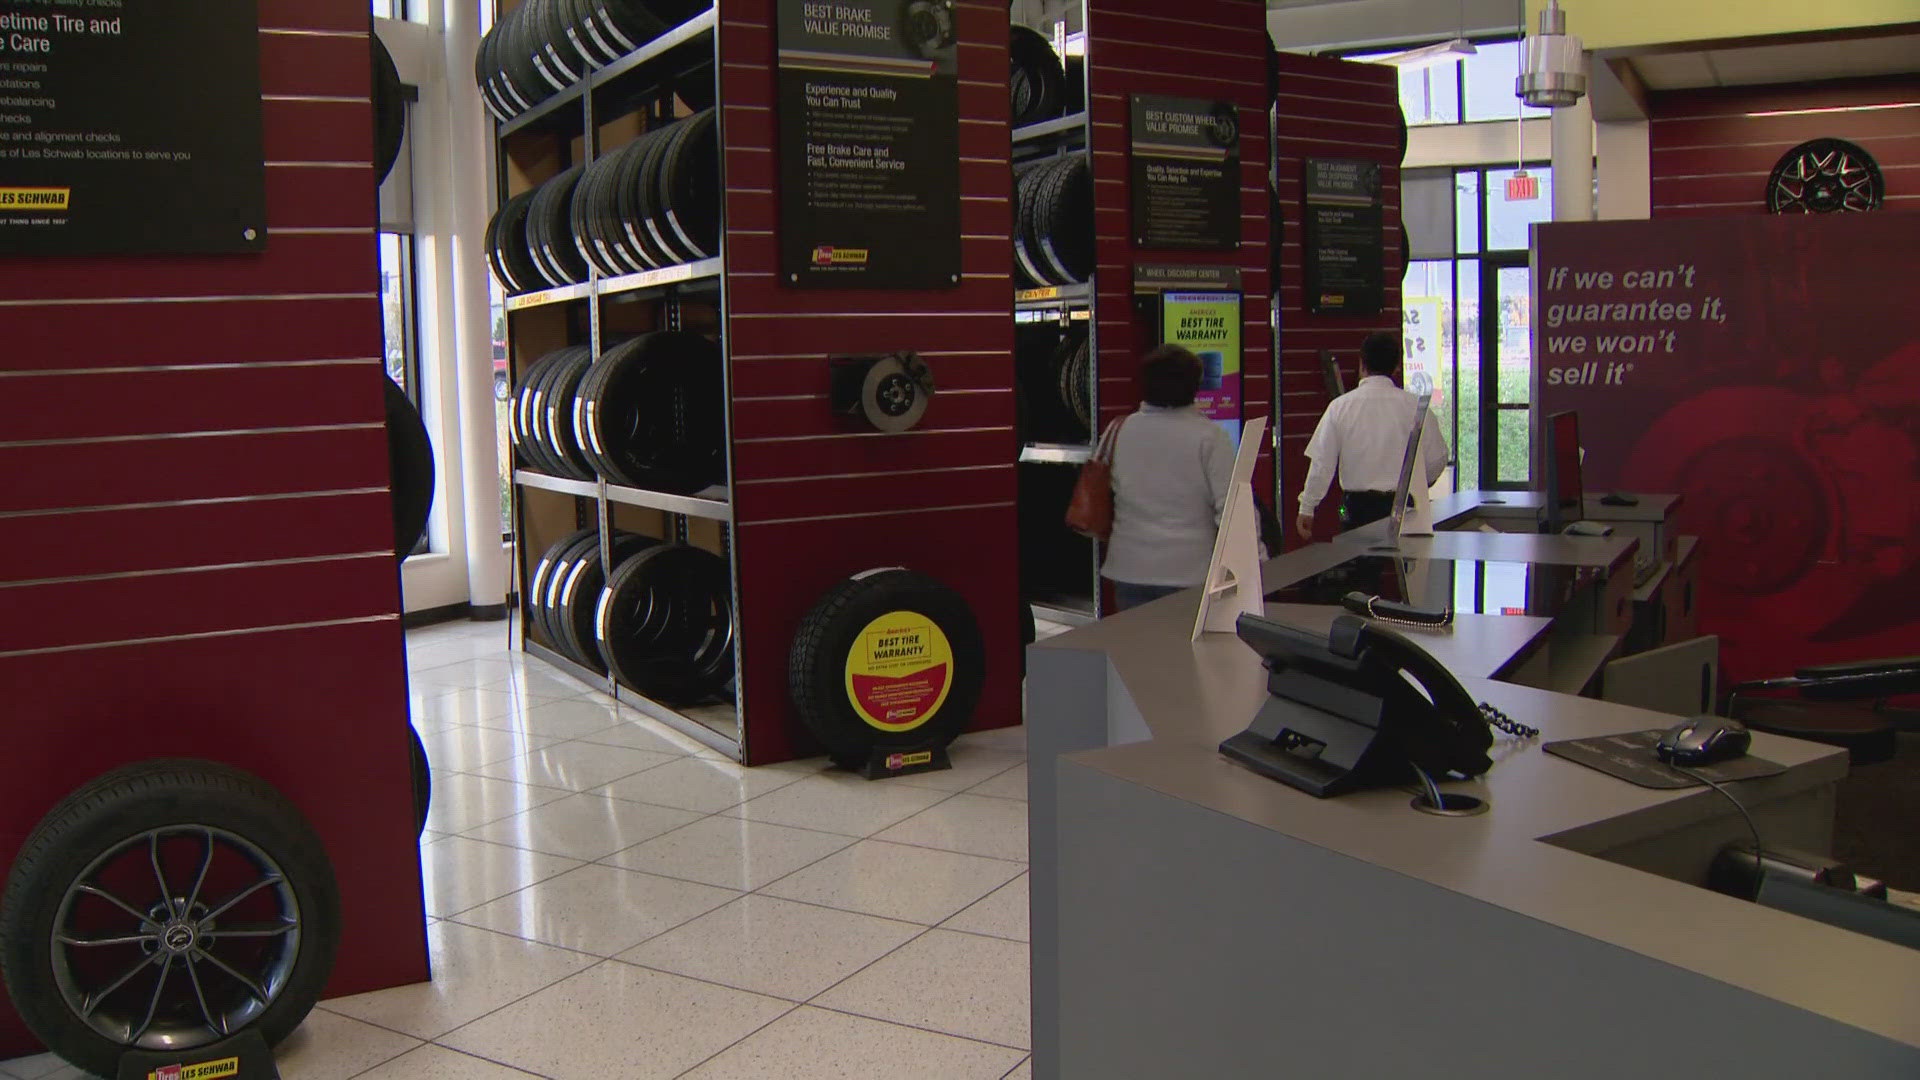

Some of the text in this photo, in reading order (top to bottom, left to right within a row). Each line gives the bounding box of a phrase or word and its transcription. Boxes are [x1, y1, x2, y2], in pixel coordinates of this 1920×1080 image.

[804, 3, 872, 22] BEST BRAKE
[53, 15, 84, 33] Tire
[90, 18, 121, 34] and
[804, 20, 891, 40] VALUE PROMISE
[10, 33, 50, 52] Care
[13, 62, 47, 73] repairs
[806, 83, 897, 101] Experience and Quality
[806, 95, 862, 109] You Can Trust
[1146, 110, 1217, 126] BEST CUSTOM WHEEL
[1146, 122, 1199, 135] VALUE PROMISE
[12, 131, 33, 141] and
[35, 131, 83, 144] alignment
[85, 132, 121, 142] checks
[10, 149, 20, 159] of
[22, 149, 41, 159] Les
[43, 149, 83, 160] Schwab
[86, 150, 131, 160] locations
[133, 150, 143, 160] to
[145, 152, 171, 161] serve
[173, 152, 191, 162] you
[807, 143, 889, 157] Free Brake Care and
[807, 155, 905, 171] Fast, Convenient Service
[1508, 178, 1534, 198] EXIT
[17, 193, 66, 205] SCHWAB
[1547, 264, 1696, 290] If we can't
[1547, 296, 1727, 328] guarantee it,
[1181, 317, 1224, 328] BEST TIRE
[1176, 329, 1228, 340] WARRANTY
[1547, 329, 1676, 353] we won't
[1547, 361, 1598, 385] sell
[878, 634, 920, 648] BEST TIRE
[874, 645, 924, 660] WARRANTY
[182, 1068, 196, 1080] LES
[198, 1061, 235, 1076] SCHWAB
